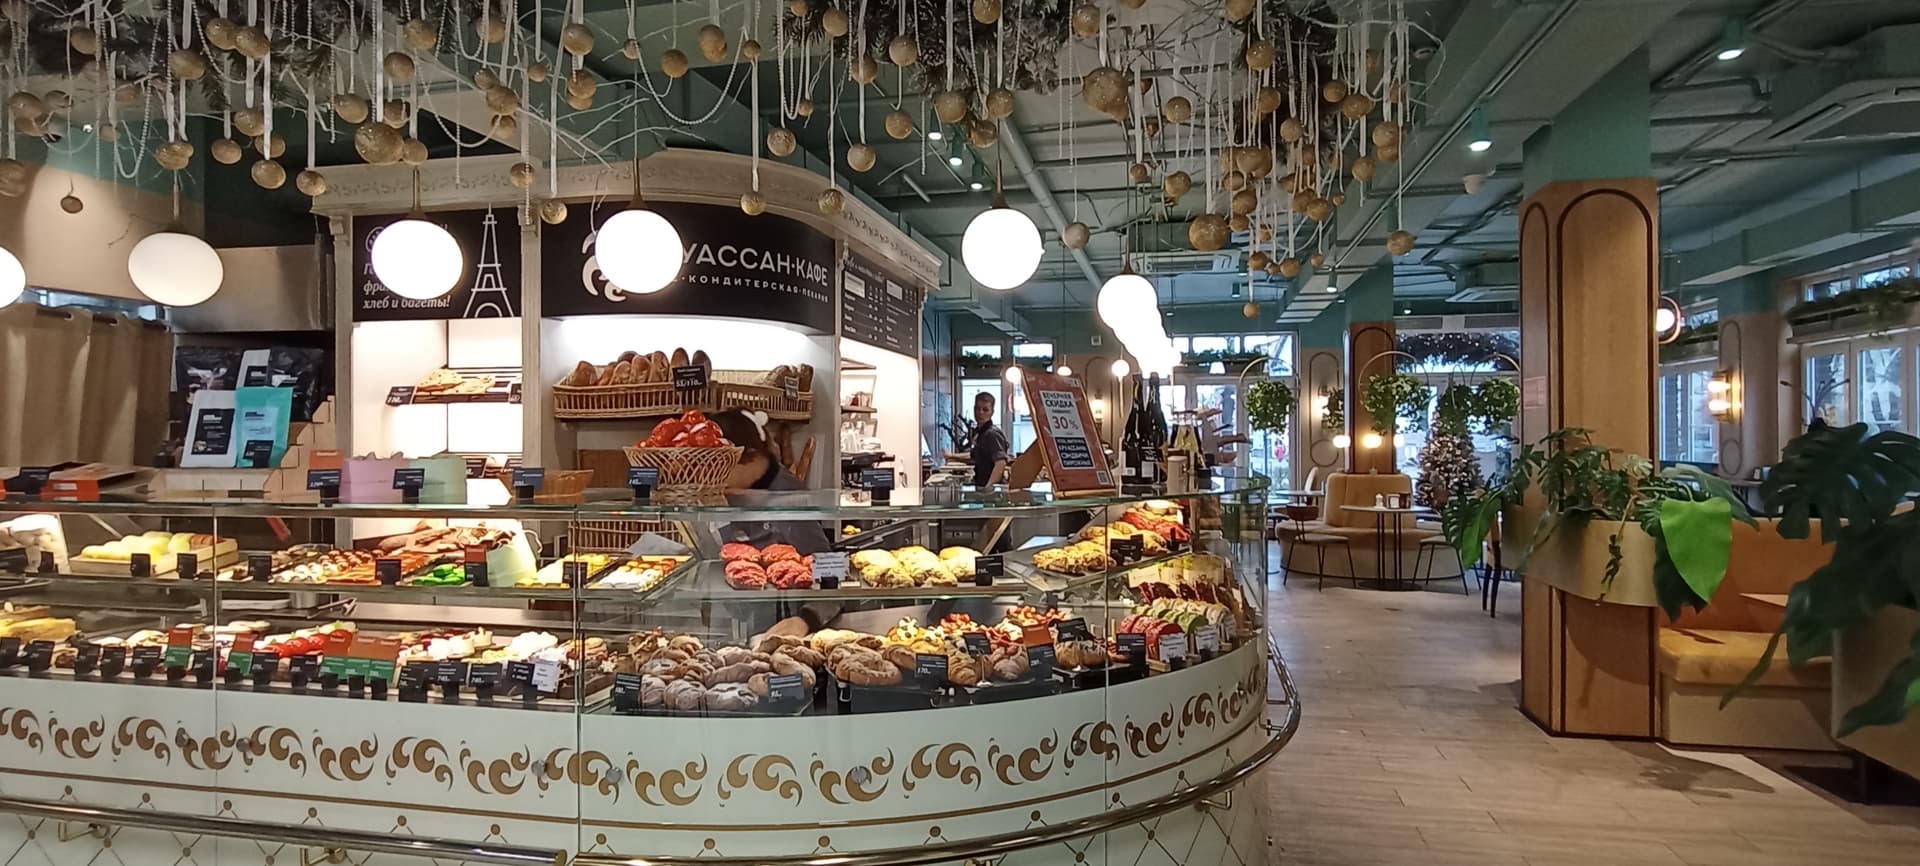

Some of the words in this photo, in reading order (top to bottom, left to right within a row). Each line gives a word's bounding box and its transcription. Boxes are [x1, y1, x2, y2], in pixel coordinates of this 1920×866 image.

[363, 295, 390, 309] хлеб
[391, 299, 399, 309] и
[1045, 400, 1074, 408] СКИДКА
